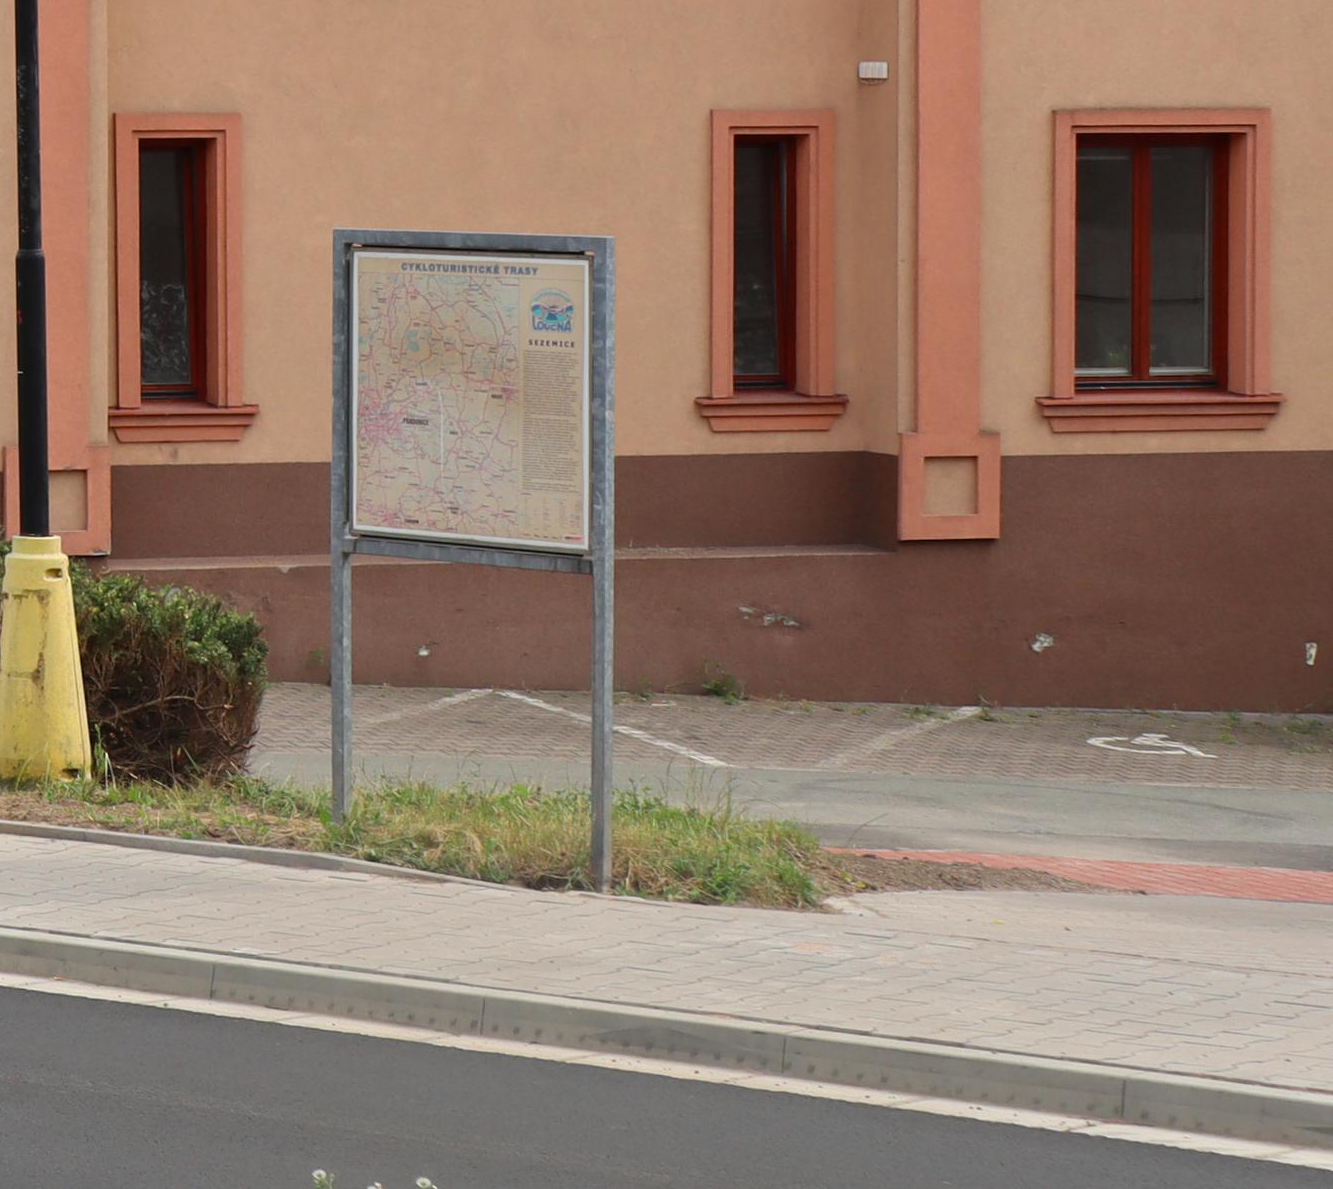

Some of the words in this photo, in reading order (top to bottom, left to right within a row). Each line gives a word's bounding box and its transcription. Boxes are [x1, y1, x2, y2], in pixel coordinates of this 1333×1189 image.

[401, 262, 500, 274] CYKLOTURISTICKÉ
[504, 266, 539, 276] TRASY
[528, 339, 576, 349] SEZEMICE
